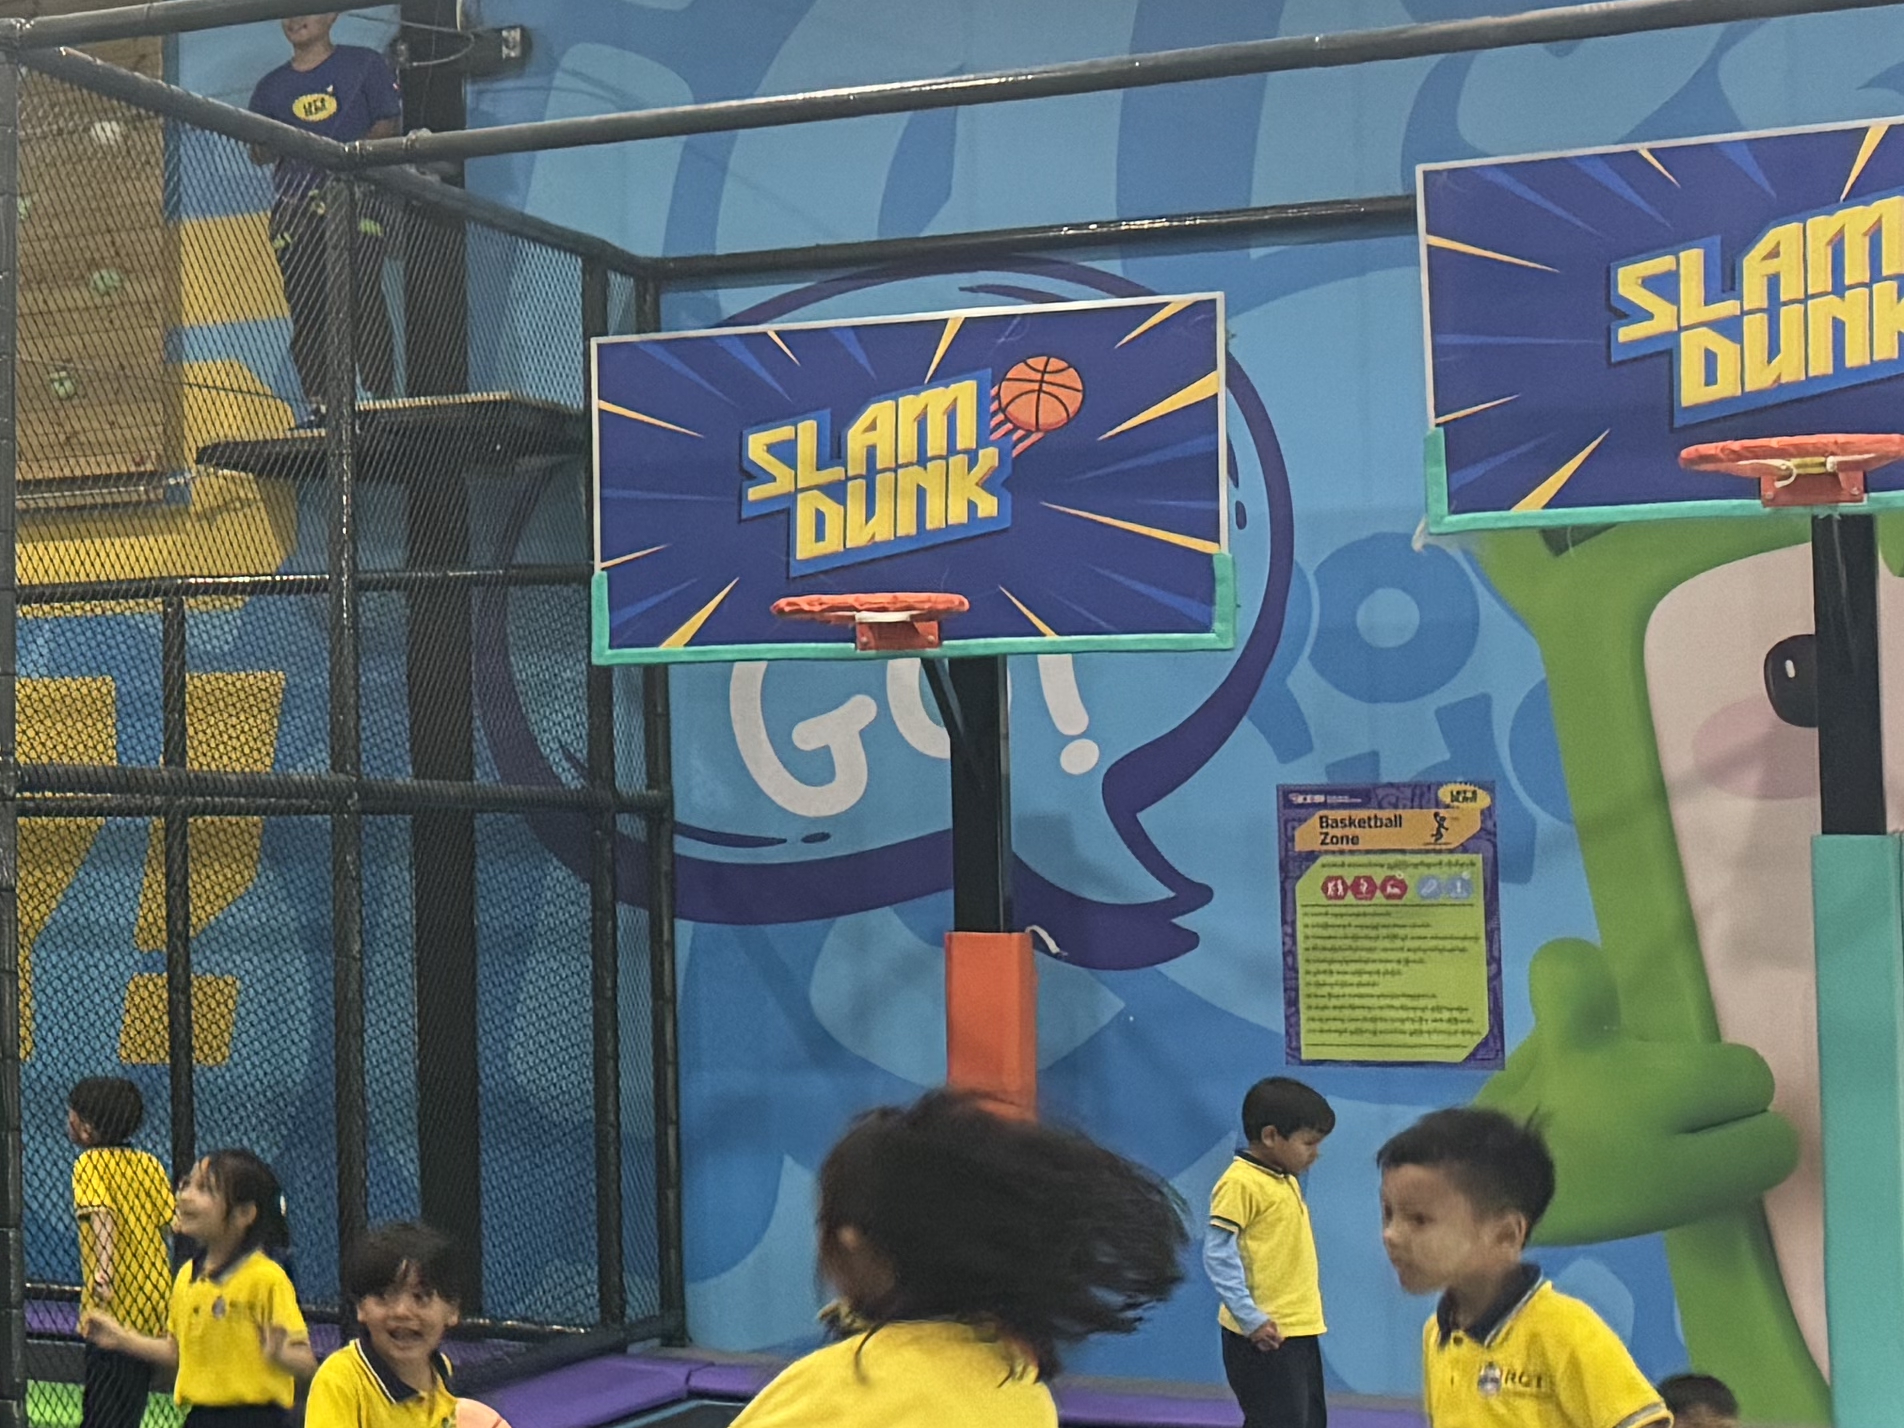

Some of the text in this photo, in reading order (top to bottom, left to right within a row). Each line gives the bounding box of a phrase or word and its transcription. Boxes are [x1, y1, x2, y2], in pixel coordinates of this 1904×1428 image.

[1618, 195, 1904, 344] SLAM
[747, 380, 977, 502] SLAM
[796, 447, 999, 560] DUNK
[1319, 814, 1403, 829] Basketball
[1320, 832, 1360, 846] Zone
